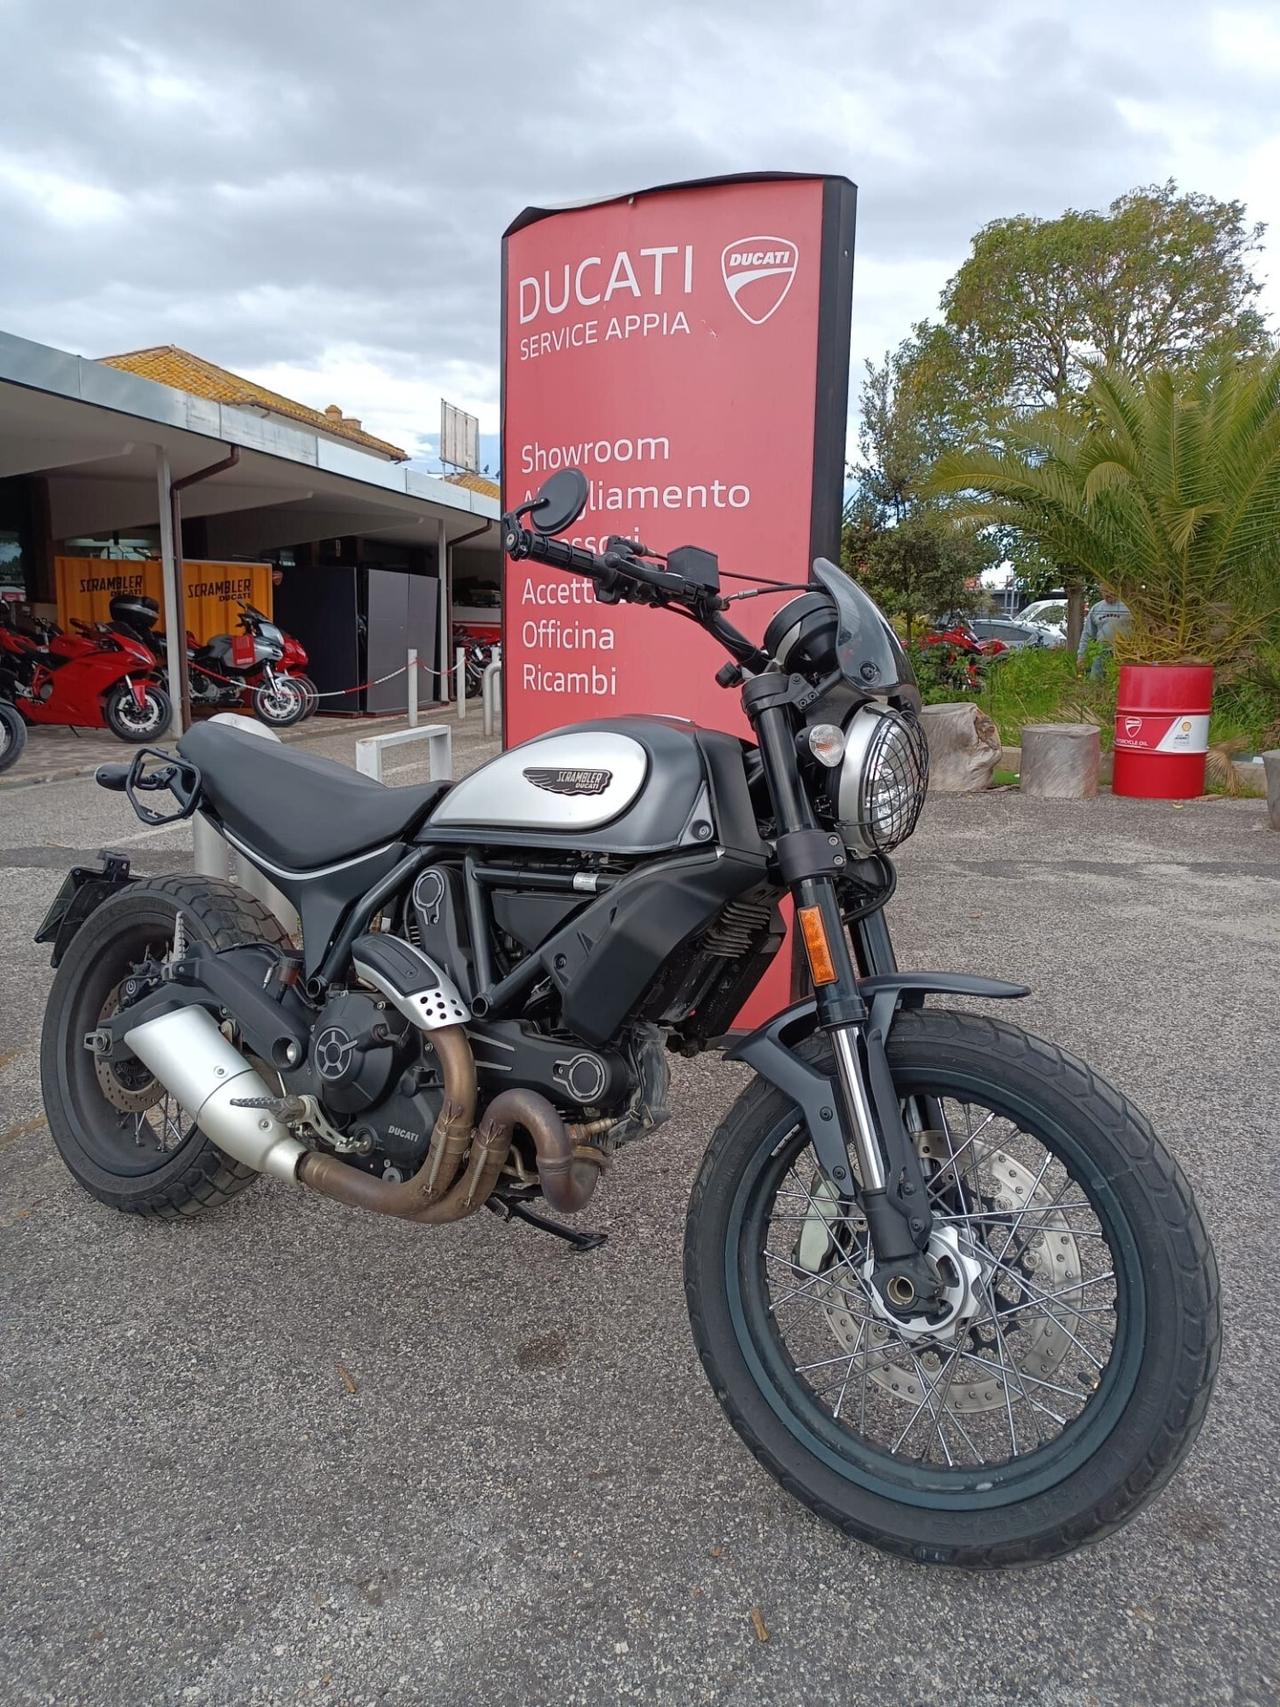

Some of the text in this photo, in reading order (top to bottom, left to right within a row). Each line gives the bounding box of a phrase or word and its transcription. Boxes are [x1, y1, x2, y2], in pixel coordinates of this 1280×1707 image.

[729, 251, 790, 267] DUCATI
[519, 245, 693, 324] DUCATI
[520, 311, 691, 361] SERVICE APPIA
[521, 436, 670, 474] Showroom
[80, 575, 143, 593] SCRAMBLER
[187, 578, 252, 598] SCRAMBLER
[219, 592, 252, 602] DUCATI
[522, 620, 615, 650] Officina
[523, 663, 617, 695] Ricambi
[556, 771, 602, 783] SCRAMBLER
[388, 1125, 419, 1142] DUCATI
